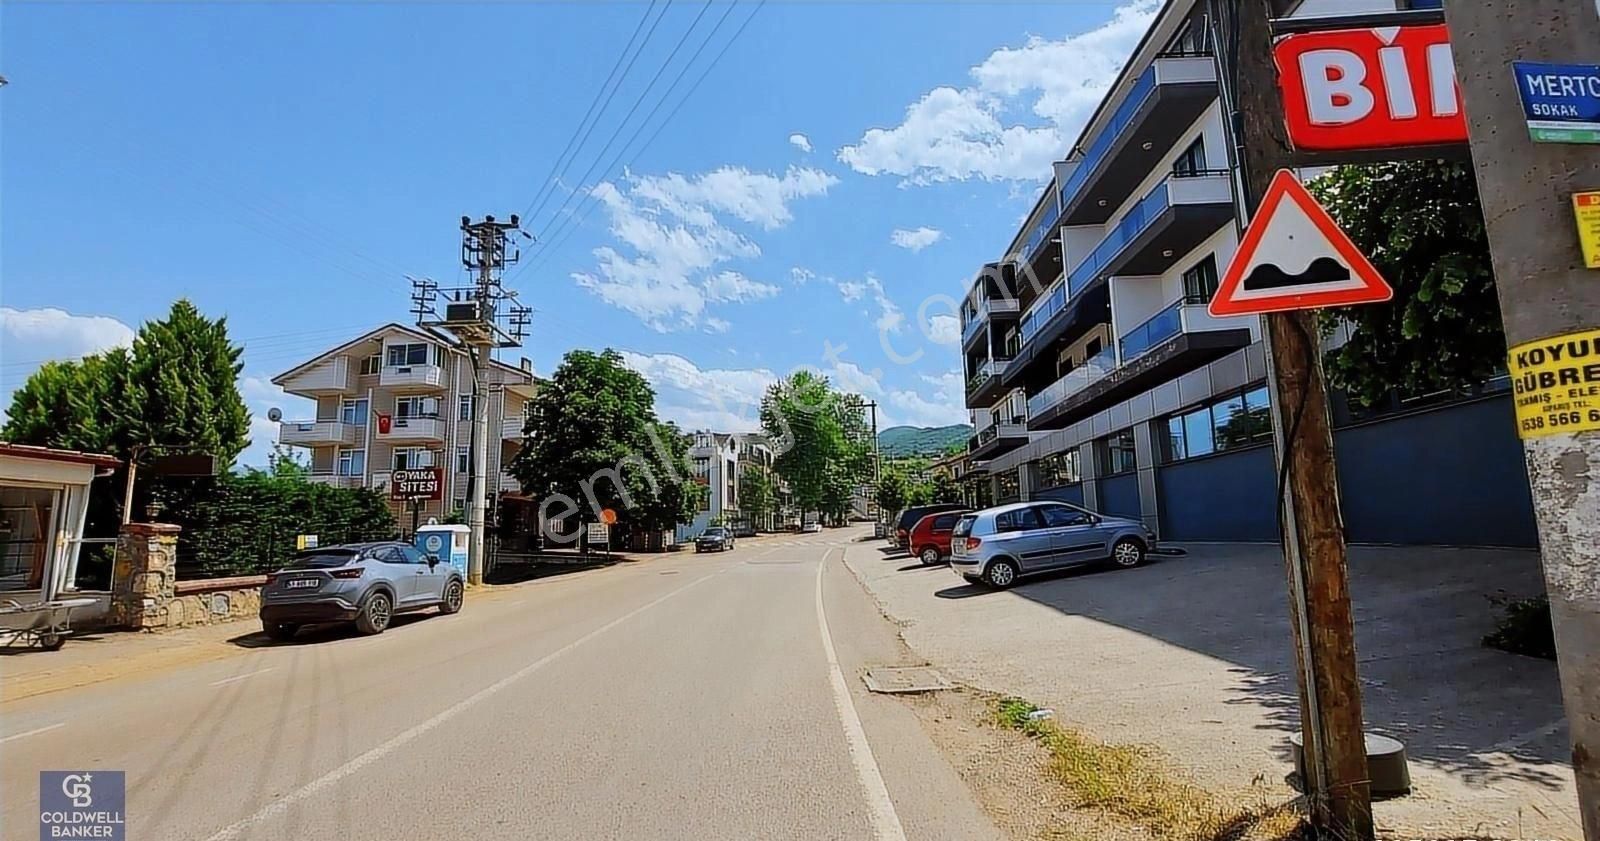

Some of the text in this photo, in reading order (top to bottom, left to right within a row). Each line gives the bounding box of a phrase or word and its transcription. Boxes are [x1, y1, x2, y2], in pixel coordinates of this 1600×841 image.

[1532, 103, 1578, 116] SOKAK
[1568, 386, 1600, 398] ELE
[1549, 411, 1580, 426] 566
[408, 471, 435, 480] YAKA
[400, 481, 438, 492] SİTESİ
